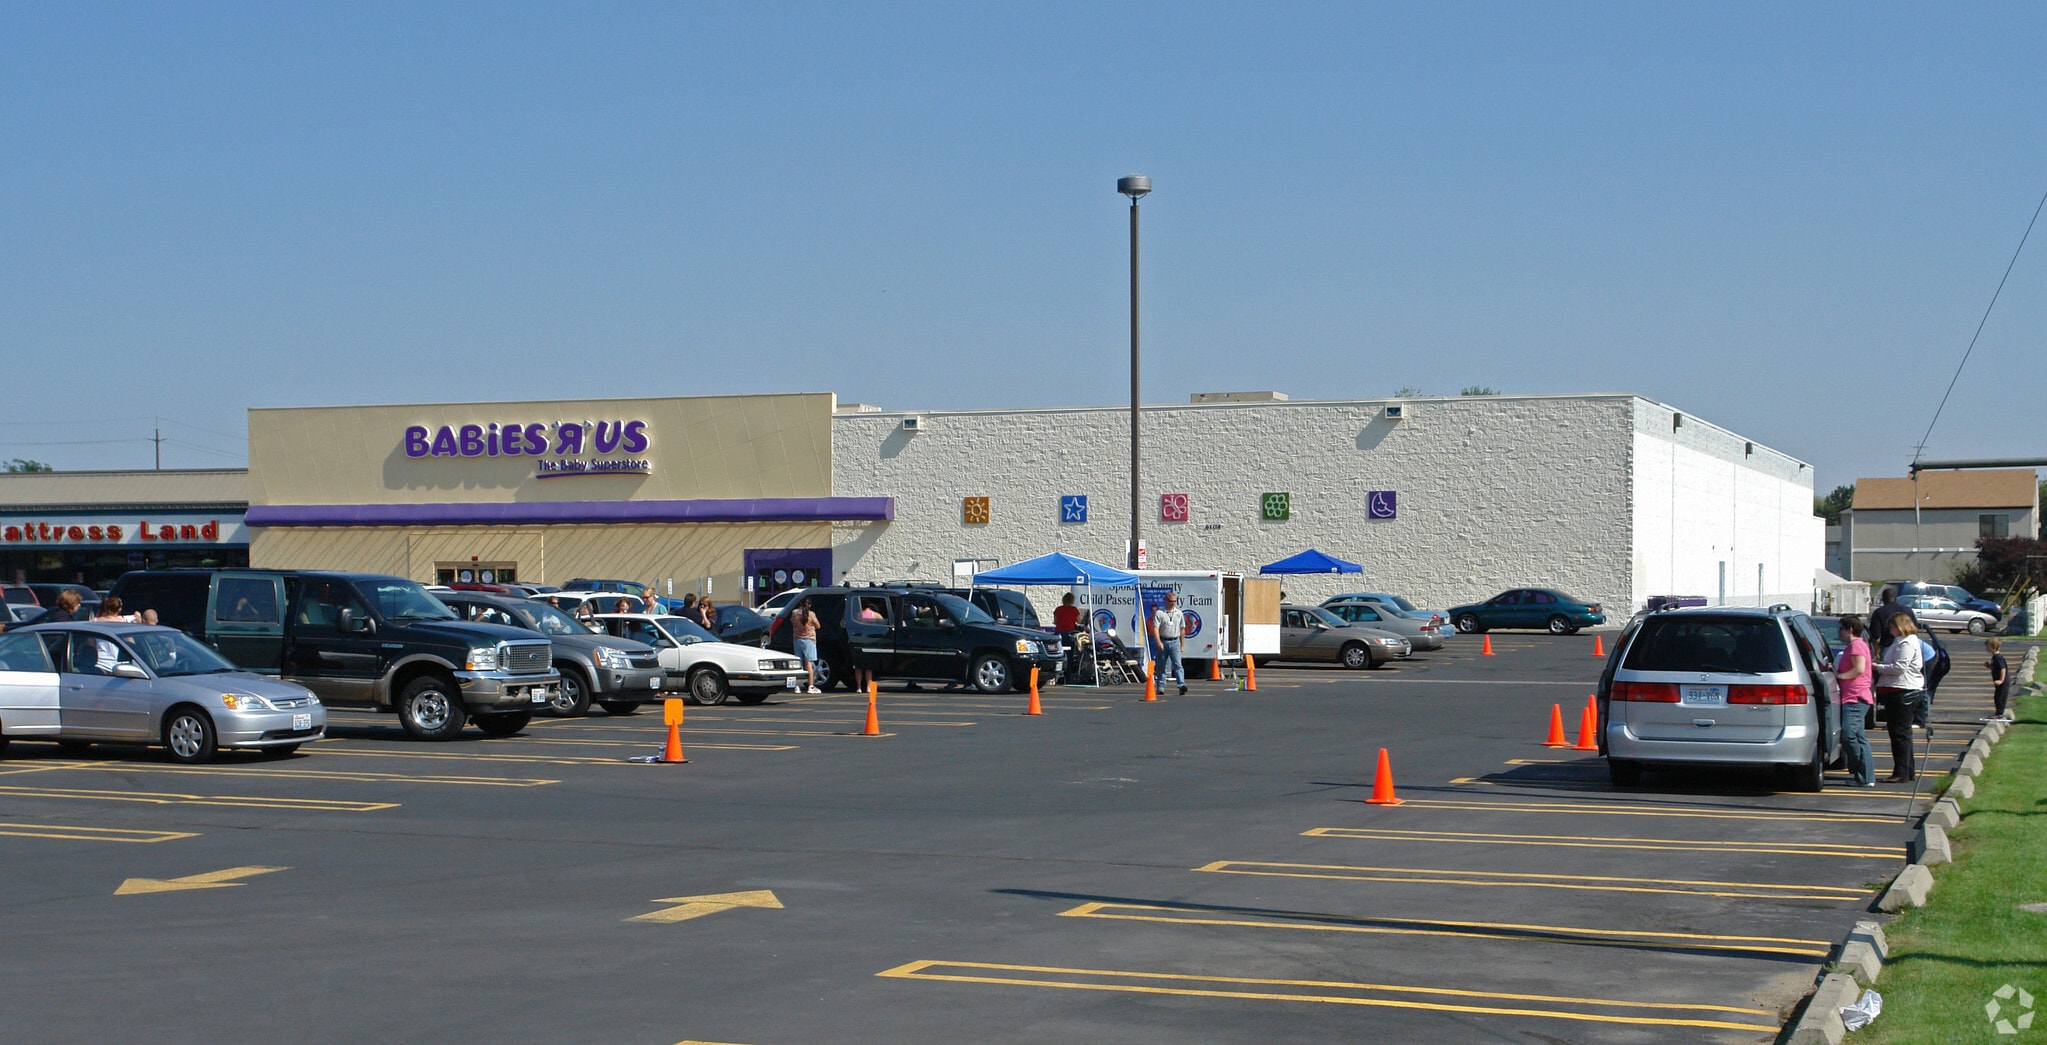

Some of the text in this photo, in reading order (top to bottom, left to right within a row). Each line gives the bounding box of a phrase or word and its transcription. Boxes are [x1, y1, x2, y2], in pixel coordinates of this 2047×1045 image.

[595, 419, 651, 454] US
[537, 457, 650, 471] The Baby Superstore
[0, 520, 219, 541] attress Land
[1151, 580, 1182, 594] County
[1080, 593, 1103, 605] Child
[1187, 594, 1213, 606] Team
